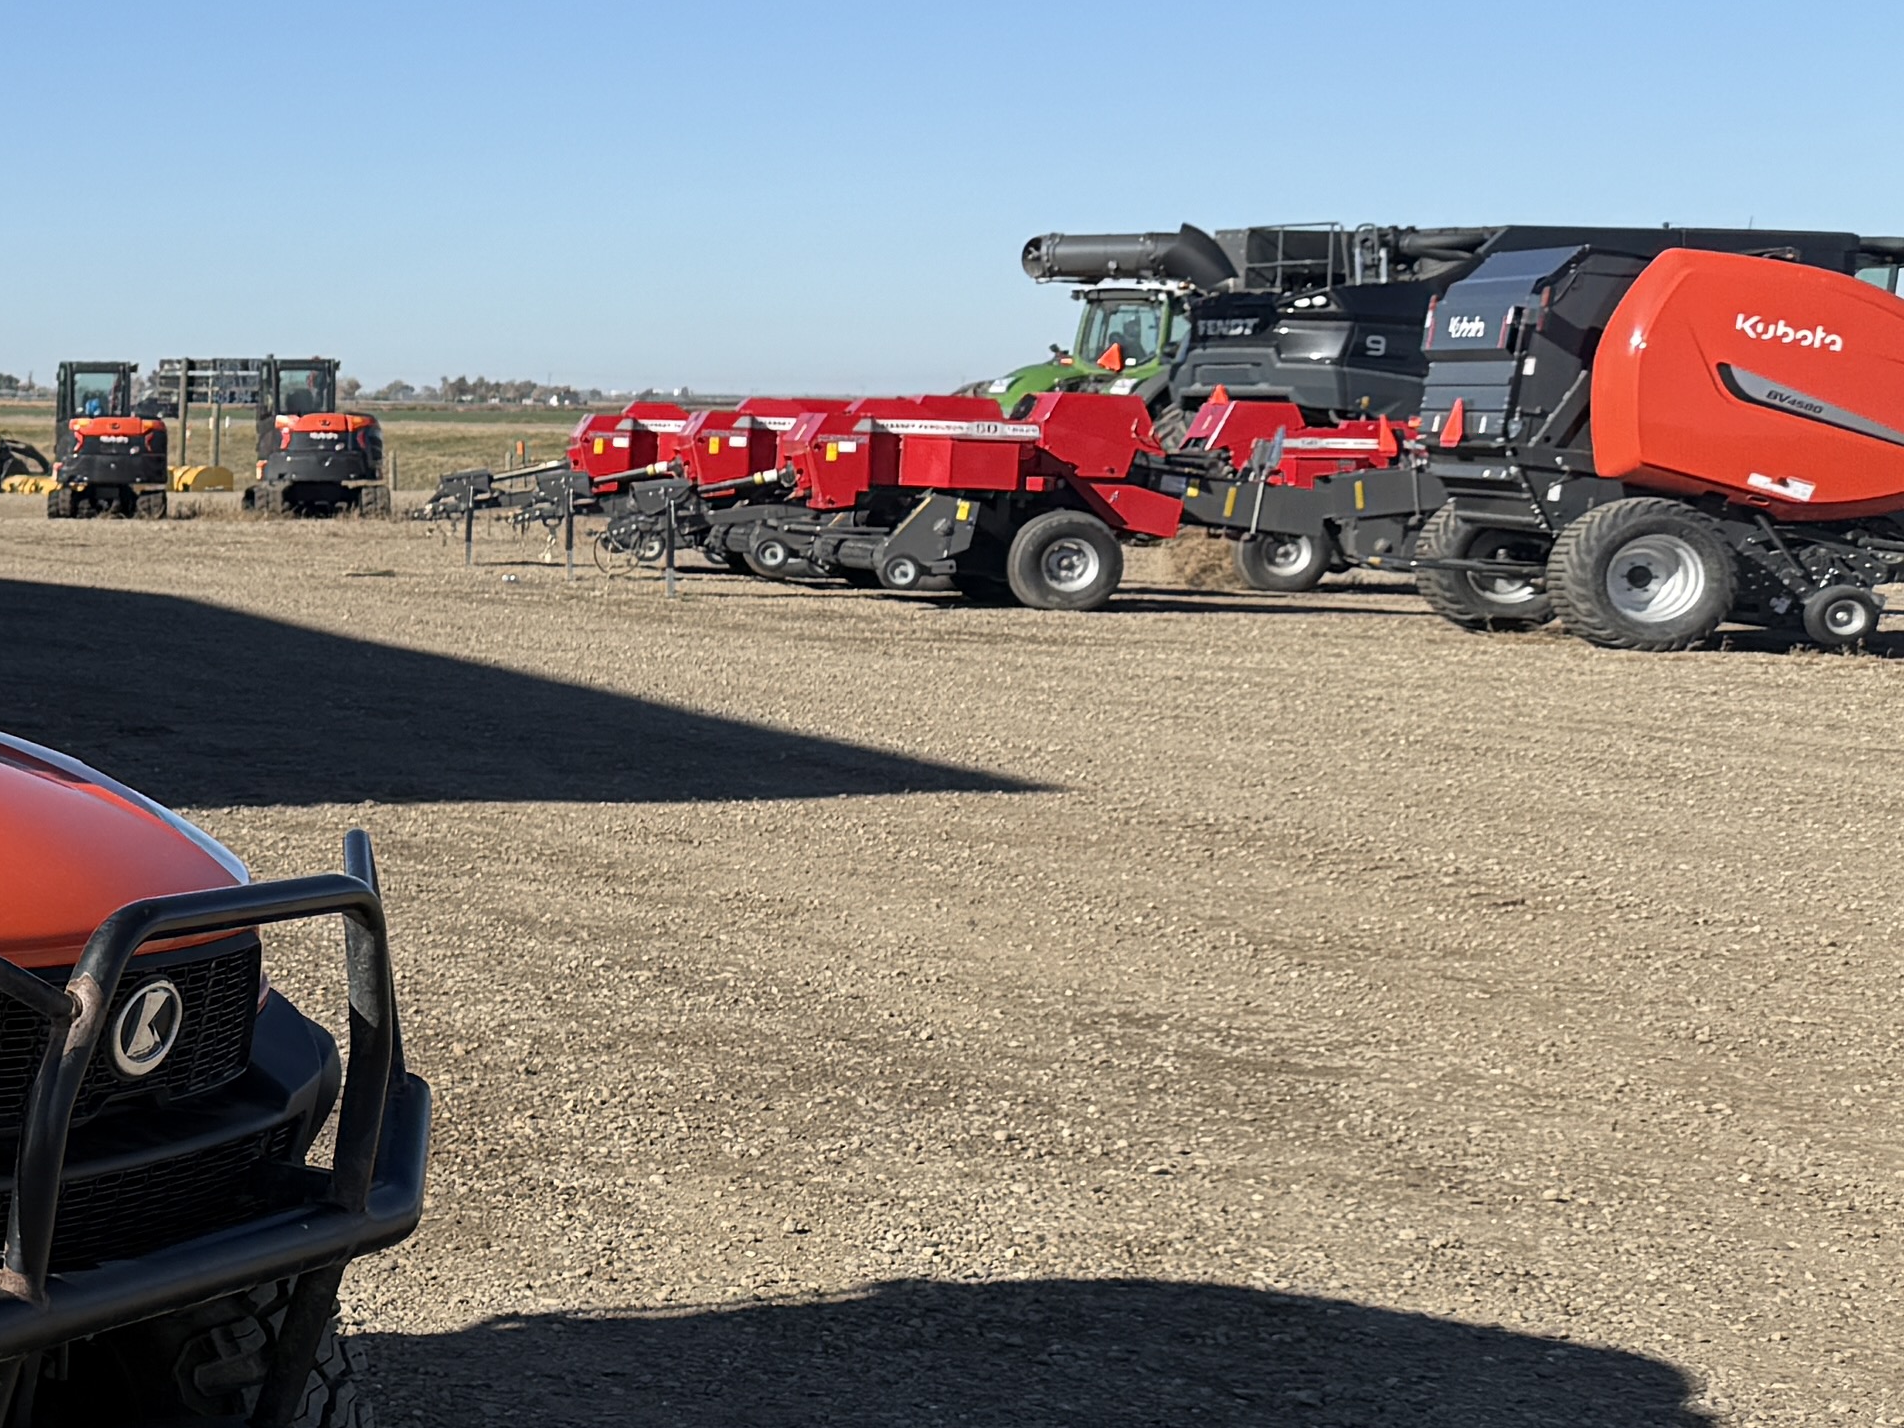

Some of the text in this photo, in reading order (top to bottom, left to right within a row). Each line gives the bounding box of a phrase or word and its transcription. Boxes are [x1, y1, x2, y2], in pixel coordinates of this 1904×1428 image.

[1197, 317, 1260, 336] FENDT
[1735, 313, 1844, 352] Kubota
[1365, 334, 1386, 357] 9
